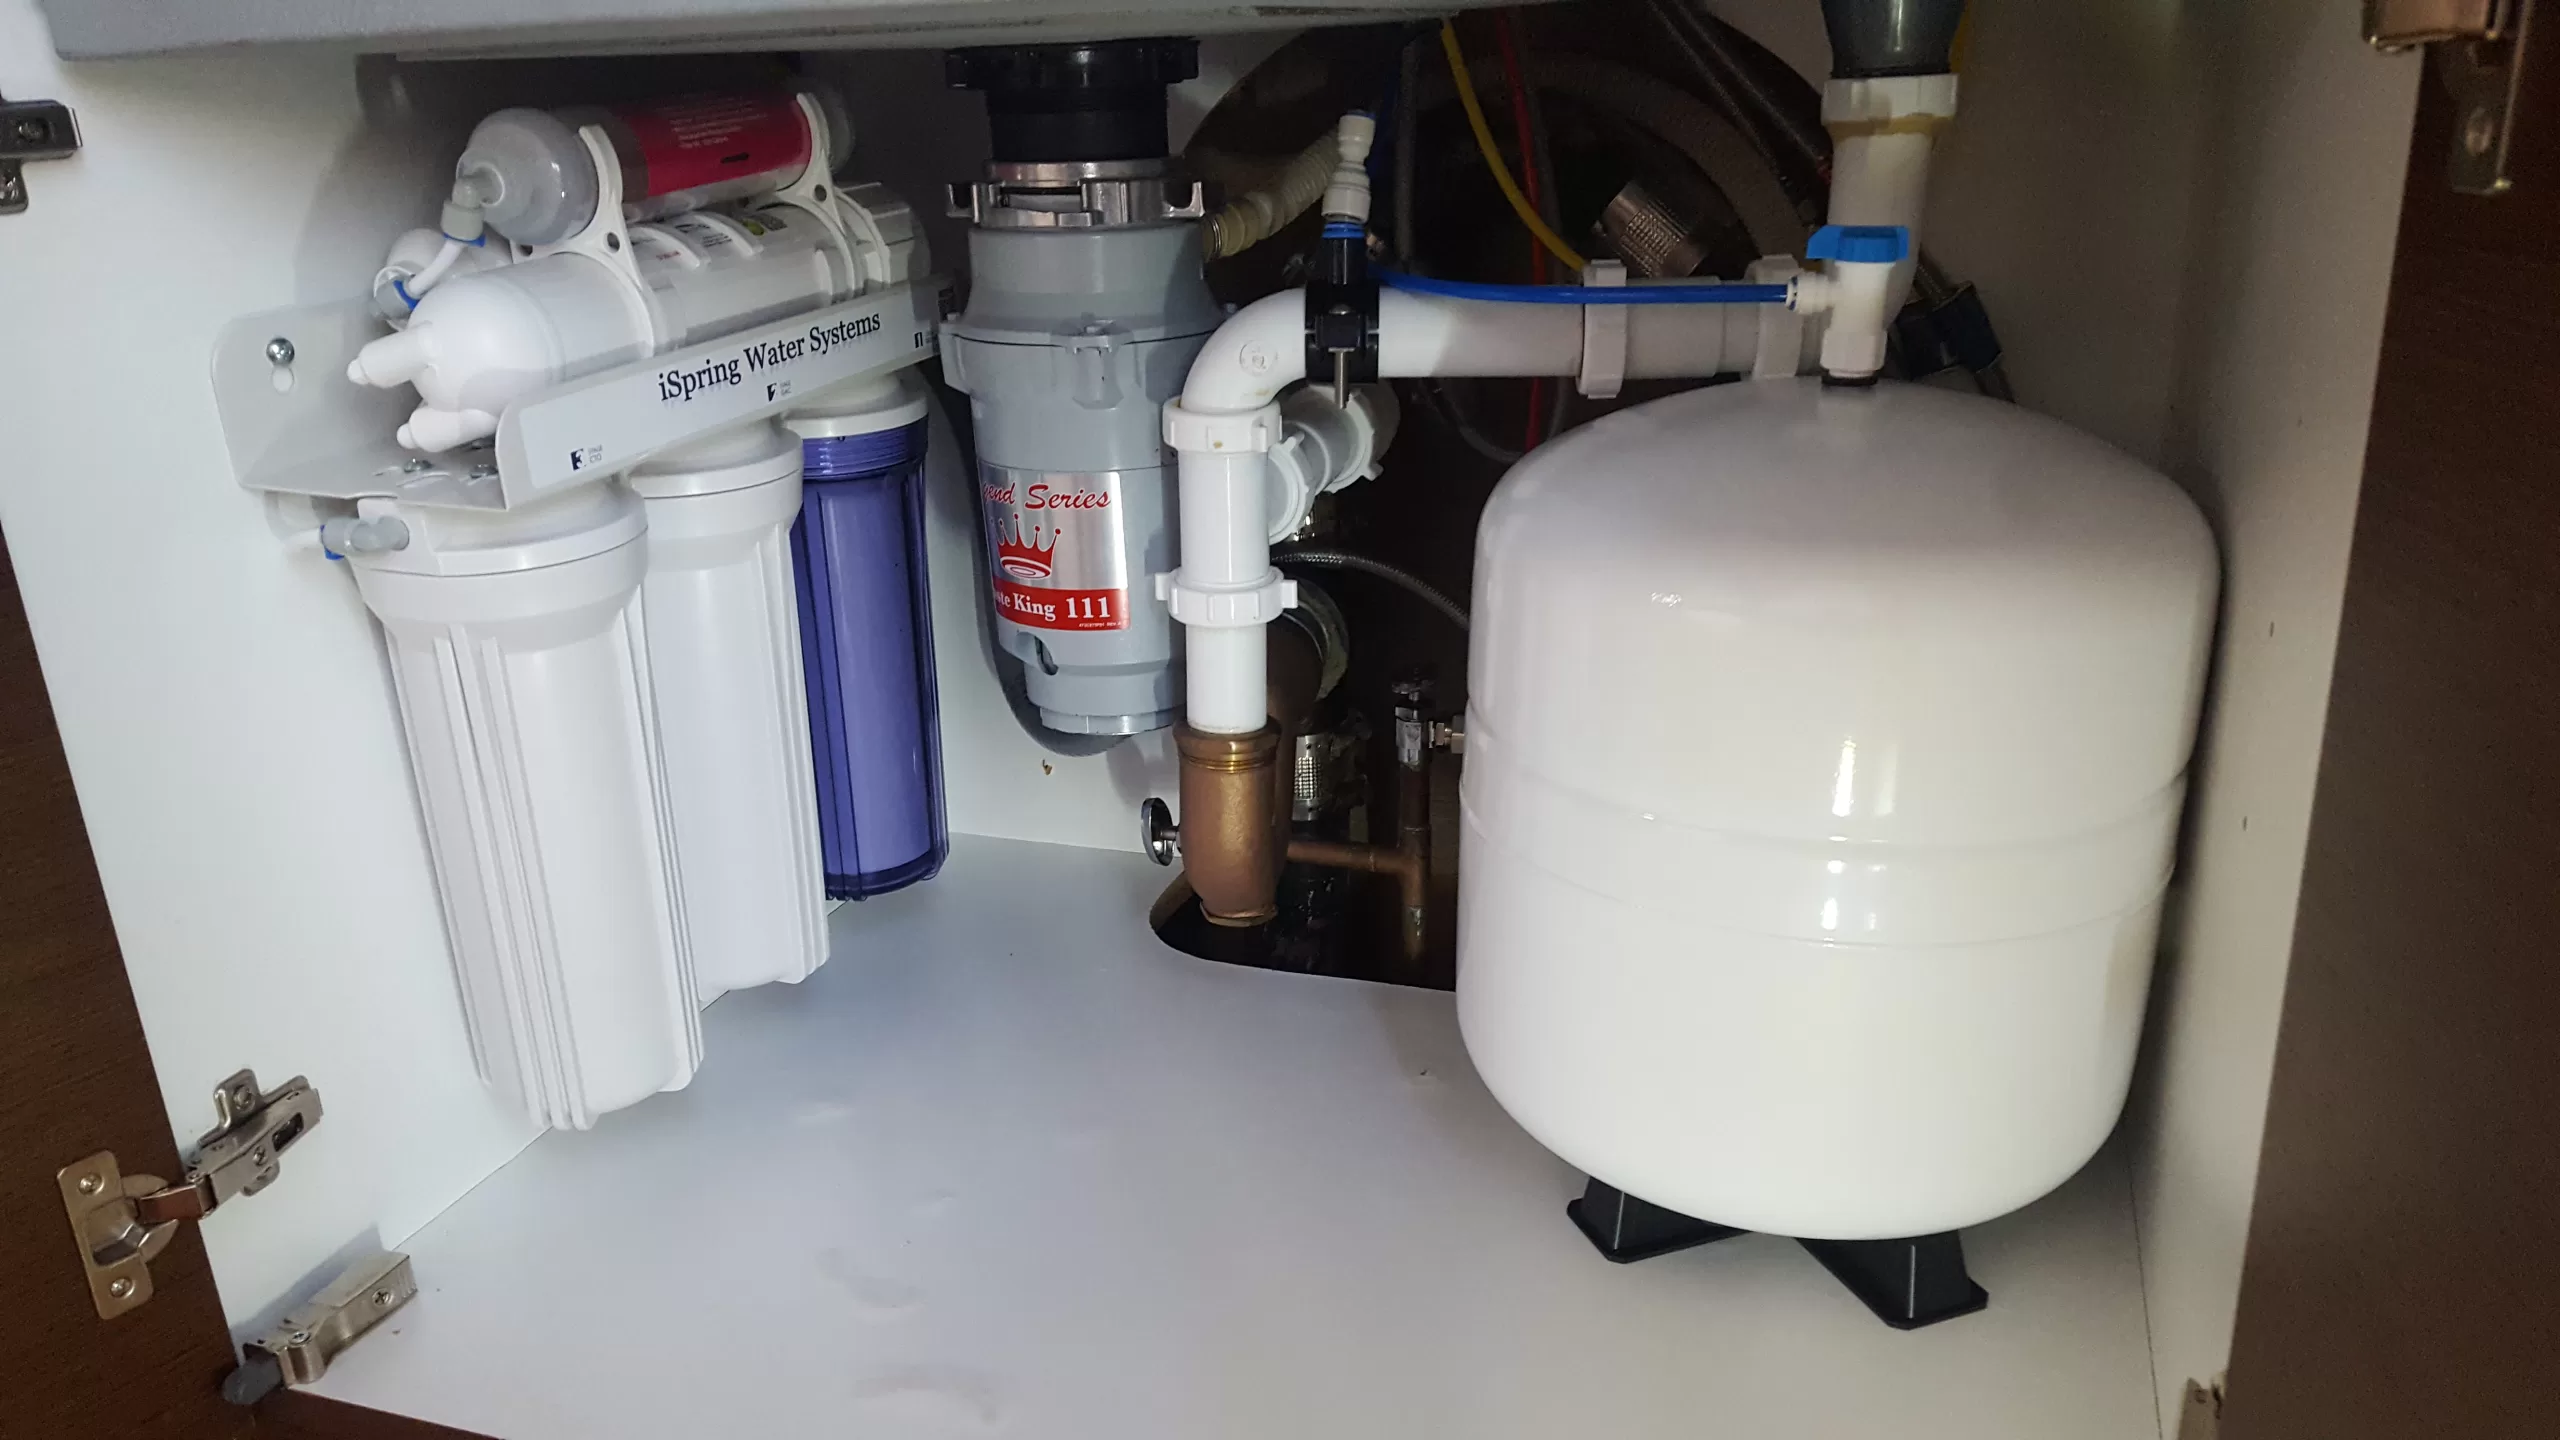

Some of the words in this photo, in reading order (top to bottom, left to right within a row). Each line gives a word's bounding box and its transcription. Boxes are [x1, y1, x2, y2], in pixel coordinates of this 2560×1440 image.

[658, 359, 742, 402] iSpring
[743, 337, 805, 373] Water
[809, 313, 881, 355] Systems
[1025, 484, 1111, 509] Series
[1013, 592, 1056, 622] King
[1066, 596, 1111, 619] 111
